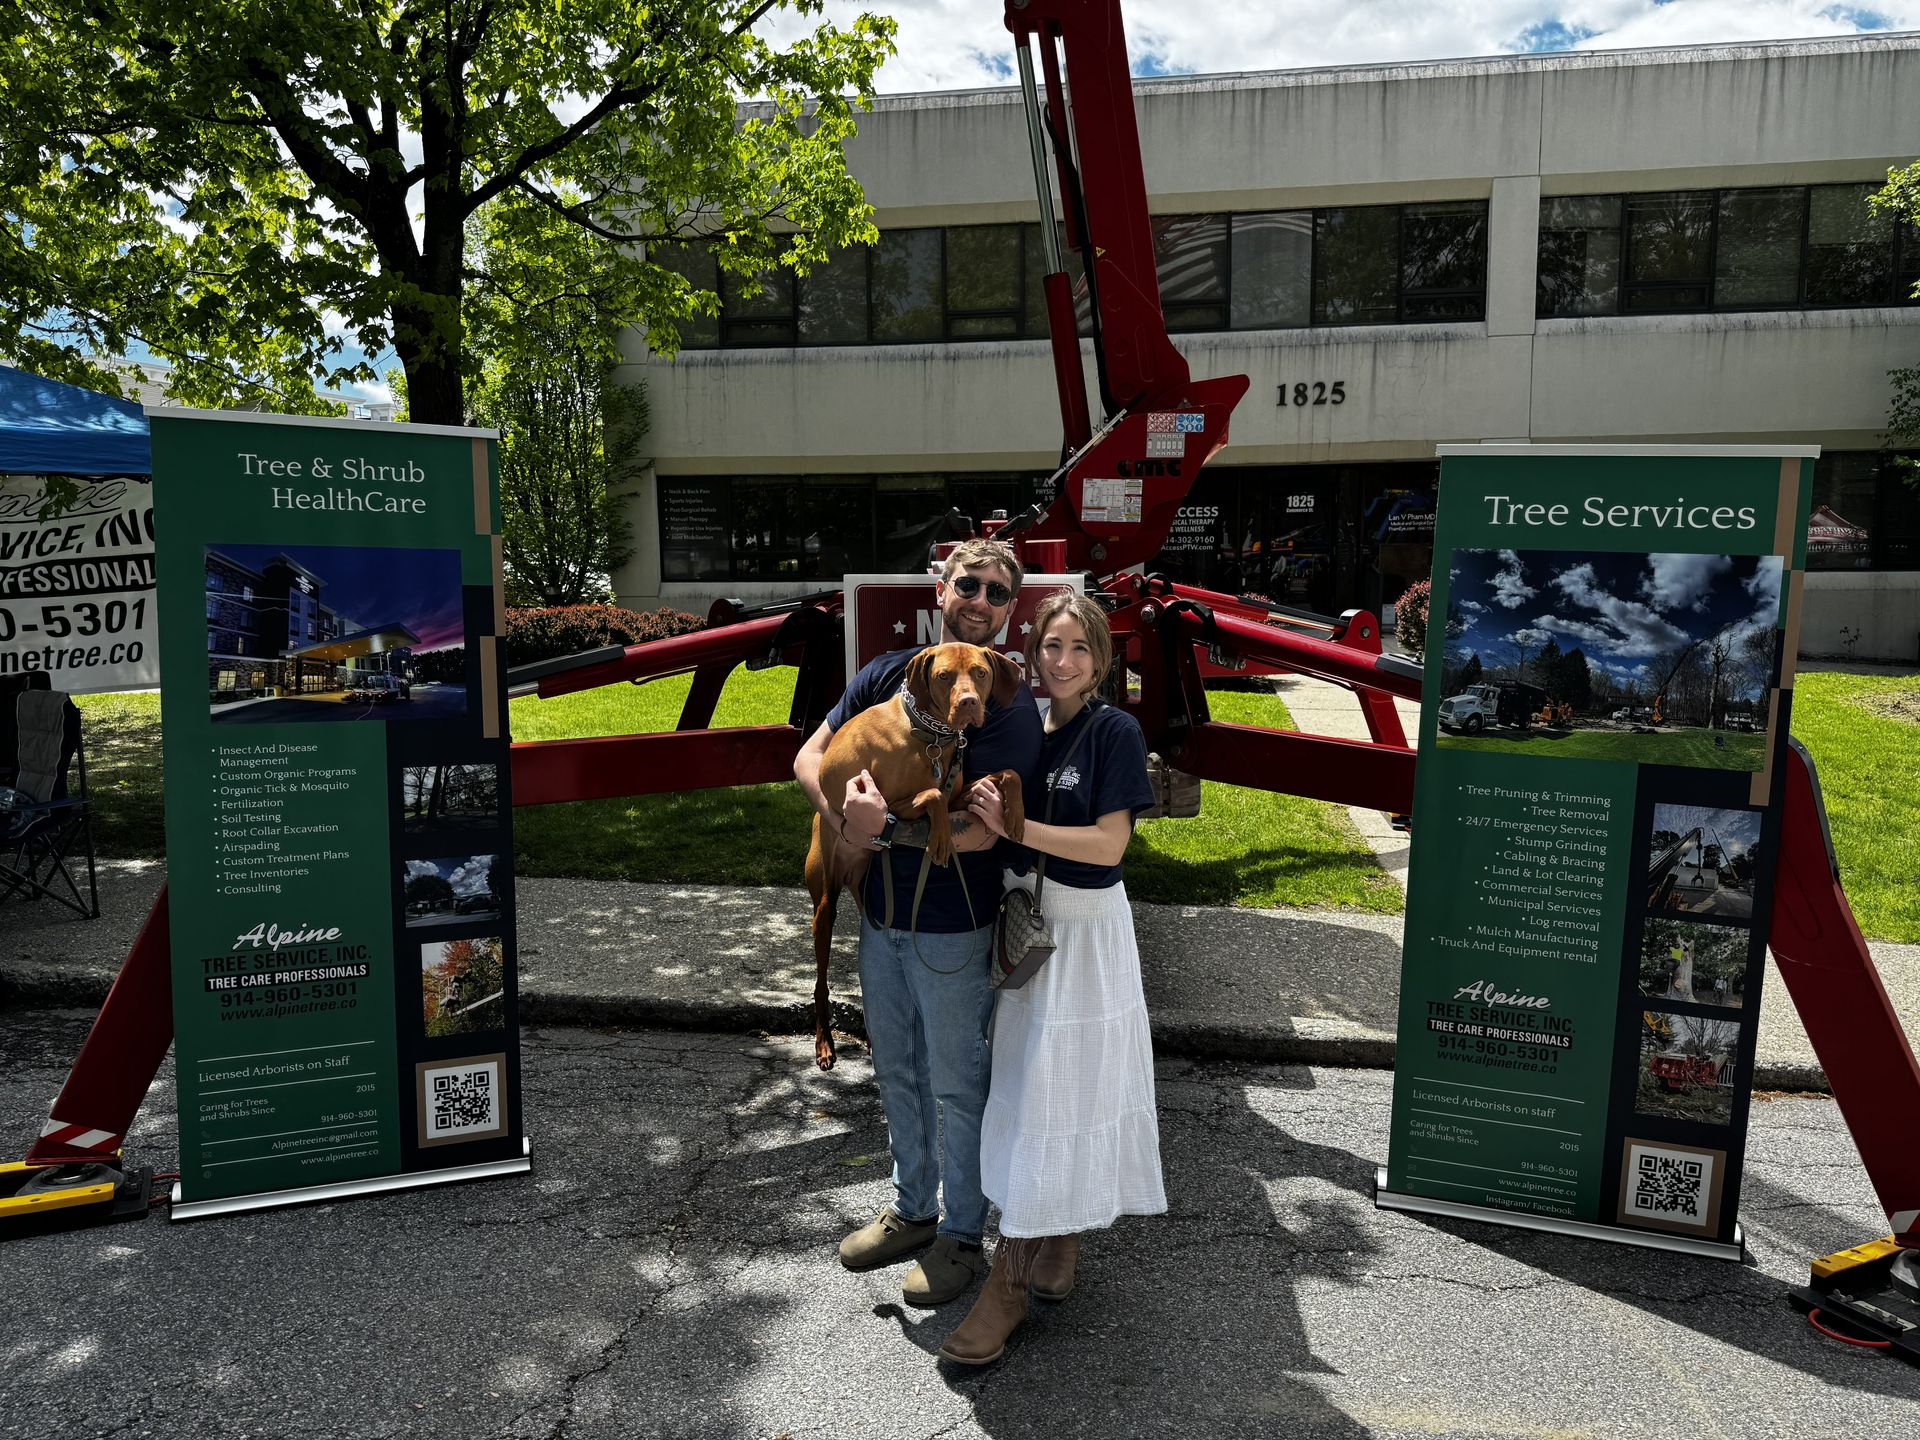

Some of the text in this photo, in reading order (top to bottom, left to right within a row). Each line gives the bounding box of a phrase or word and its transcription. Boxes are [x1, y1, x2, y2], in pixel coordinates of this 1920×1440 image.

[1276, 381, 1346, 406] 1825
[238, 453, 425, 483] Tree & Shrub
[272, 487, 426, 514] HealthCare
[1286, 495, 1314, 507] 1825
[1175, 506, 1219, 517] CCESS
[1484, 496, 1756, 530] Tree Services
[0, 524, 85, 560] VICE,
[0, 559, 156, 593] FESSIONAL
[0, 598, 145, 642] 0-5301
[0, 641, 143, 672] netree.co
[219, 744, 318, 755] Insect And Disease
[220, 757, 288, 768] Management
[220, 768, 357, 780] Custom Organic Programs
[221, 781, 349, 797] Organic Tick & Mosquito
[1466, 785, 1611, 808] Tree Pruning & Trimming
[221, 799, 284, 809] Fertilization
[1531, 806, 1609, 821] Tree Removal
[222, 813, 281, 823] Soil Testing
[1465, 816, 1608, 837] 24/7 Emergency Services
[223, 824, 339, 838] Root Collar Excavation
[223, 841, 280, 853] Airspading
[1515, 836, 1607, 855] Stump Grinding
[223, 851, 349, 866] Custom Treatment Plans
[1504, 850, 1606, 871] Cabling & Bracing
[223, 867, 309, 880] Tree Inventories
[1492, 865, 1604, 887] Land & Lot Clearing
[224, 883, 281, 894] Consulting
[1482, 880, 1602, 900] Commercial Services
[1487, 895, 1601, 916] Municipal Servicves
[1530, 916, 1600, 932] Log removal
[232, 922, 343, 951] Alpine
[1476, 925, 1598, 950] Mulch Manufacturing
[201, 945, 372, 973] TREE SERVICE, INC.
[1438, 936, 1597, 964] Truck And Equipment rental
[208, 964, 367, 990] TREE CARE PROFESSIONALS
[221, 982, 357, 1007] 914-960-5301
[1453, 980, 1551, 1008] Alpine
[221, 999, 357, 1021] www.alpinetree.co
[1426, 1001, 1576, 1033] TREE SERVICE, INC.
[1430, 1019, 1570, 1048] TREE CARE PROFESSIONALS
[1439, 1035, 1558, 1062] 914-960-5301
[199, 1055, 350, 1082] Licensed Arborists on Staff
[1437, 1050, 1557, 1074] www.alpinetree.co
[356, 1083, 376, 1093] 2015
[200, 1098, 268, 1112] Caring for Trees
[200, 1106, 275, 1122] and Shrubs Since
[1413, 1089, 1556, 1118] Licensed Arborists on staff
[321, 1109, 377, 1123] 914-960-5301
[1409, 1128, 1479, 1146] and Shrubs Since
[1410, 1120, 1473, 1135] Caring for Trees
[271, 1128, 378, 1150] Alpinetreeinc@gmail.com
[1559, 1142, 1579, 1151] 2015
[301, 1149, 379, 1165] www.alpinetree.co
[1521, 1161, 1578, 1177] 914-960-5301
[1498, 1178, 1576, 1197] www.alpinetree.co
[1486, 1194, 1574, 1216] Instagram/ Facebook:
